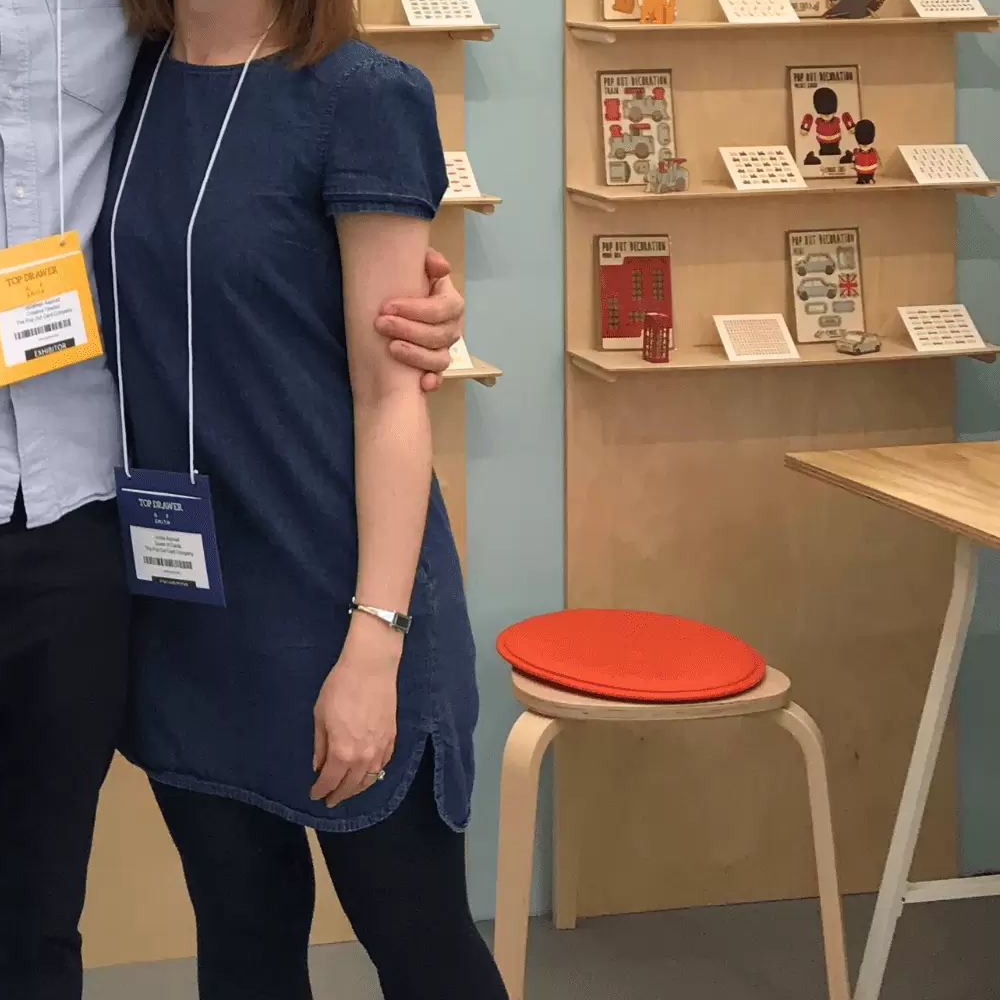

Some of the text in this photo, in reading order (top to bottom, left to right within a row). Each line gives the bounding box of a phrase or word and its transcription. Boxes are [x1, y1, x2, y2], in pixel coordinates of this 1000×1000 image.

[603, 77, 614, 86] POP
[631, 75, 667, 86] DECORATION
[602, 242, 612, 251] POP
[6, 266, 58, 287] TOP DRAWER
[34, 342, 67, 357] EXHIBITOR
[138, 498, 183, 512] TOP DRAWER
